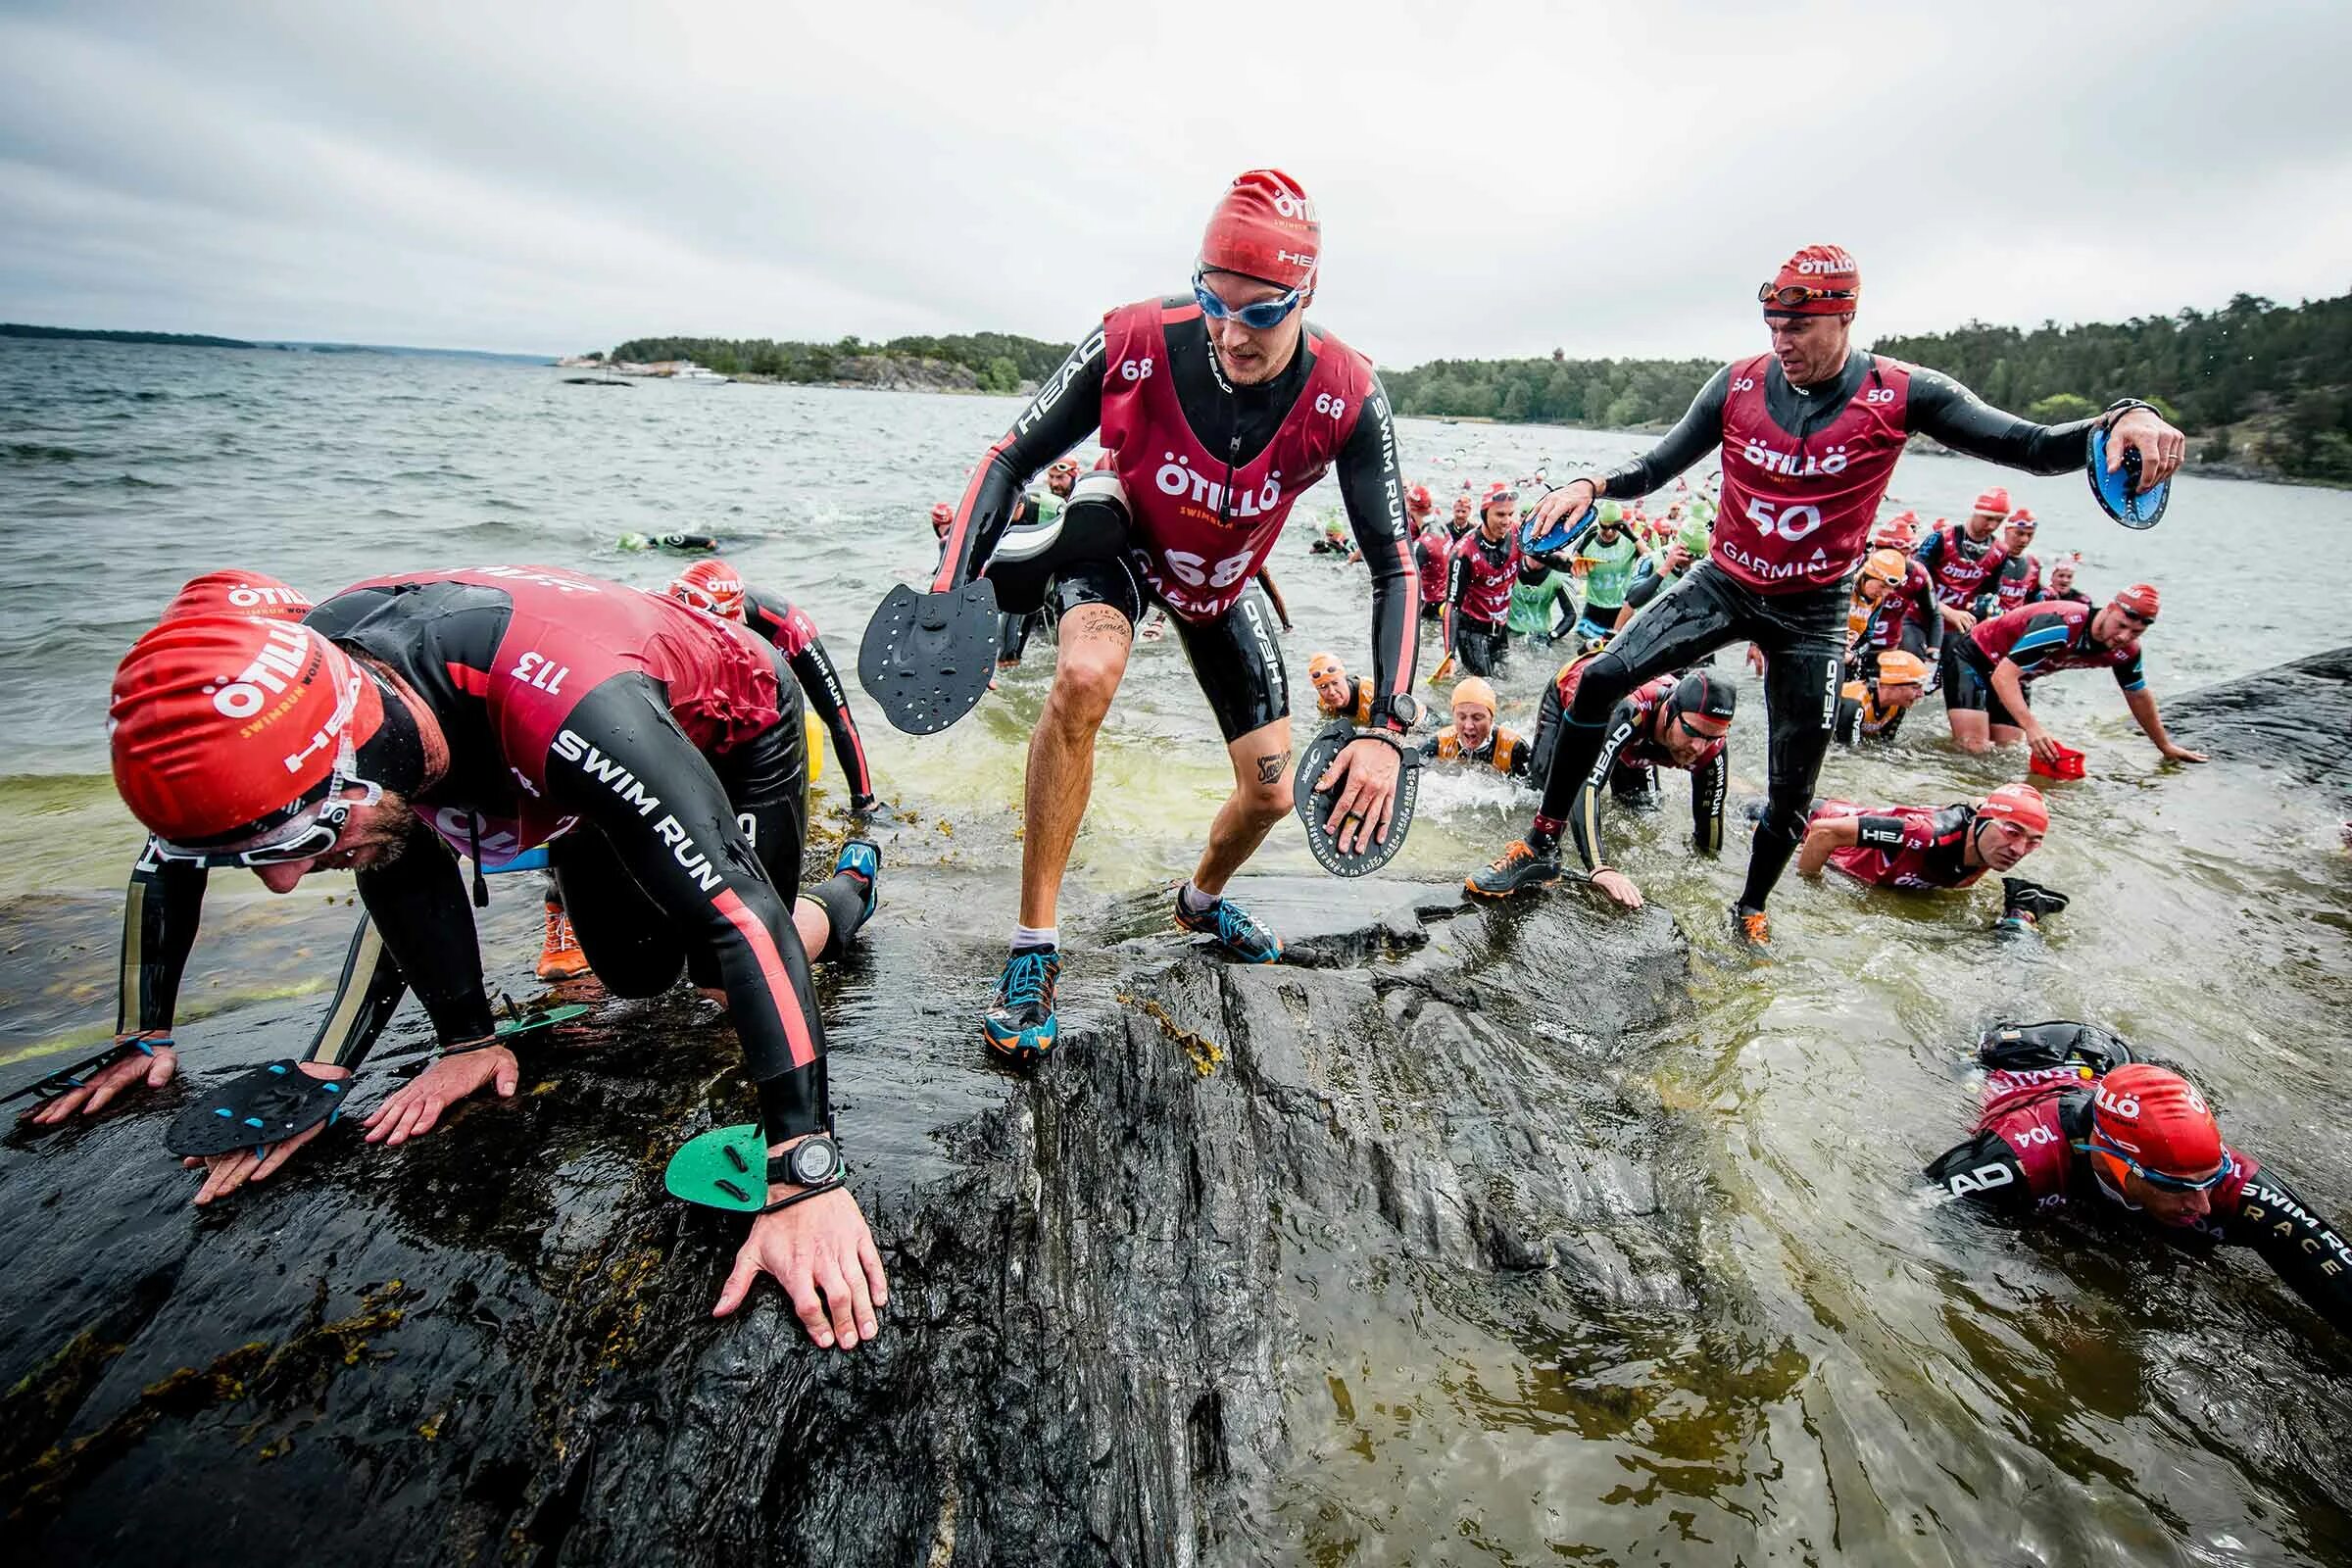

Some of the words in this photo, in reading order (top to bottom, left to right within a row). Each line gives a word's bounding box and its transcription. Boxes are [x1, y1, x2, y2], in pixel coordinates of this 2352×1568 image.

[1798, 258, 1855, 274] ÖTILLÖ
[1017, 330, 1105, 435] HEAD
[1121, 358, 1153, 381] 68
[1207, 341, 1233, 394] HEAD
[1315, 393, 1346, 420] 68
[1867, 388, 1895, 403] 50
[1372, 397, 1395, 472] SWIM
[1385, 478, 1405, 536] RUN
[1744, 437, 1848, 476] ÖTILLÖ
[1155, 451, 1282, 517] ÖTILLÖ
[1745, 497, 1821, 542] 50
[1164, 549, 1254, 588] 68
[1448, 560, 1462, 603] HEAD
[1723, 541, 1828, 580] GARMIN
[1243, 600, 1282, 685] HEAD
[511, 651, 570, 696] 113
[805, 642, 830, 676] SWIM
[824, 677, 844, 707] RUN
[1821, 659, 1838, 730] HEAD
[239, 685, 307, 739] SWIMRUN
[1587, 722, 1633, 786] HEAD
[551, 729, 661, 816] SWIM
[654, 813, 723, 893] RUN
[1711, 788, 1724, 816] RUN
[2014, 1124, 2059, 1149] 104
[2240, 1182, 2320, 1229] SWIM
[2243, 1203, 2343, 1276] RACE
